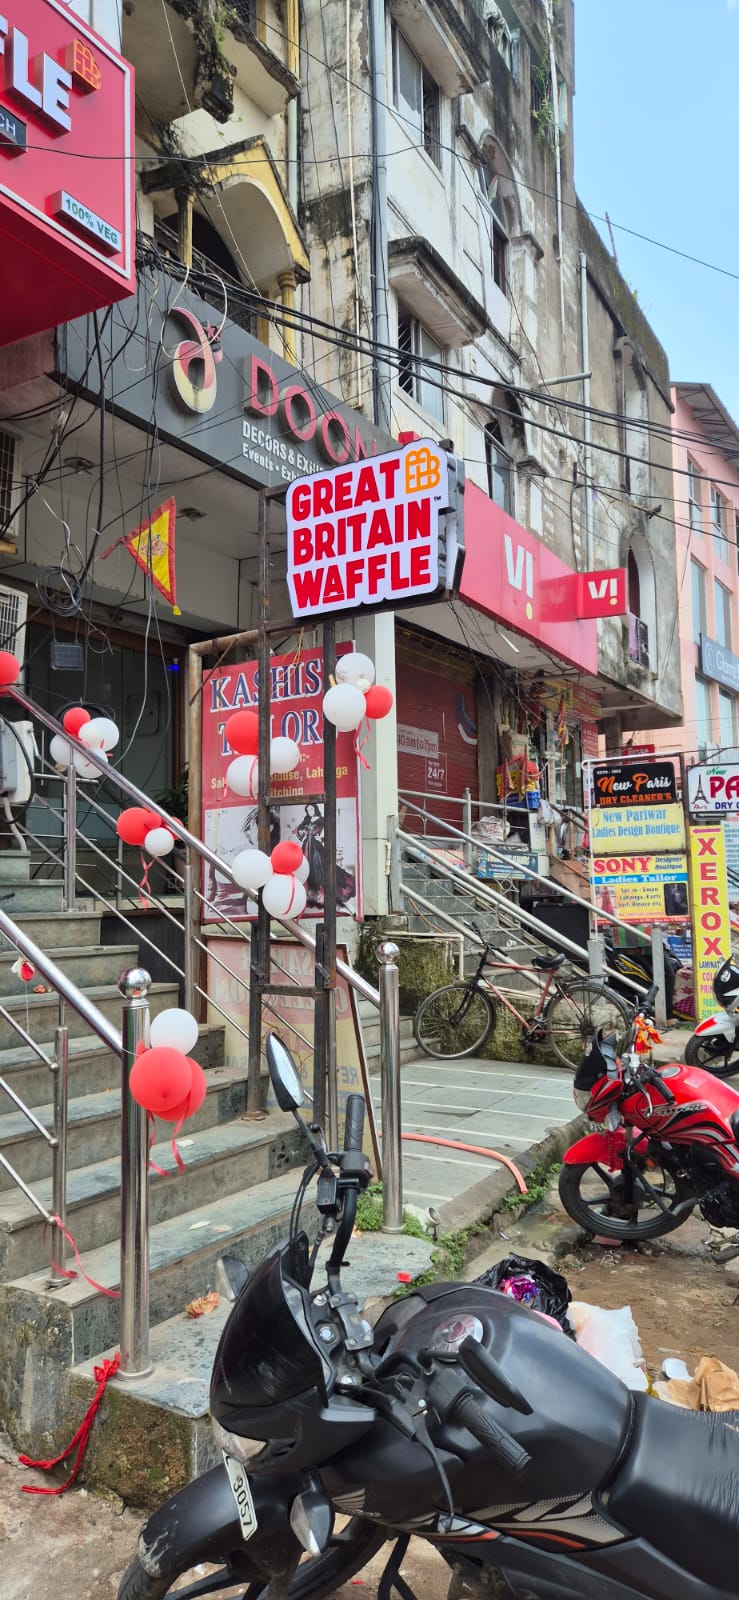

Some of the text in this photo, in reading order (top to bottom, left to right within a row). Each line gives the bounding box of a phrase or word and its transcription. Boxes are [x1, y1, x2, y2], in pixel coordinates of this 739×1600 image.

[65, 198, 118, 244] 100% VEG
[243, 420, 287, 460] DECORS
[288, 449, 295, 465] &
[242, 442, 274, 471] Events
[291, 458, 400, 522] GREAT
[292, 497, 431, 566] BRITAIN
[292, 545, 431, 609] WAFFLE
[428, 766, 445, 780] 24/7
[597, 773, 672, 794] New Paris
[600, 796, 617, 805] DRY
[620, 793, 672, 804] CLEANER'S
[603, 809, 666, 822] New Pariwar
[593, 823, 681, 838] Ladies Design Boutique
[593, 857, 652, 874] SONY
[641, 874, 678, 882] Tailor
[697, 837, 723, 956] XEROX
[699, 961, 720, 969] LAMINAT
[702, 972, 714, 982] COL
[233, 1475, 252, 1526] 3057
